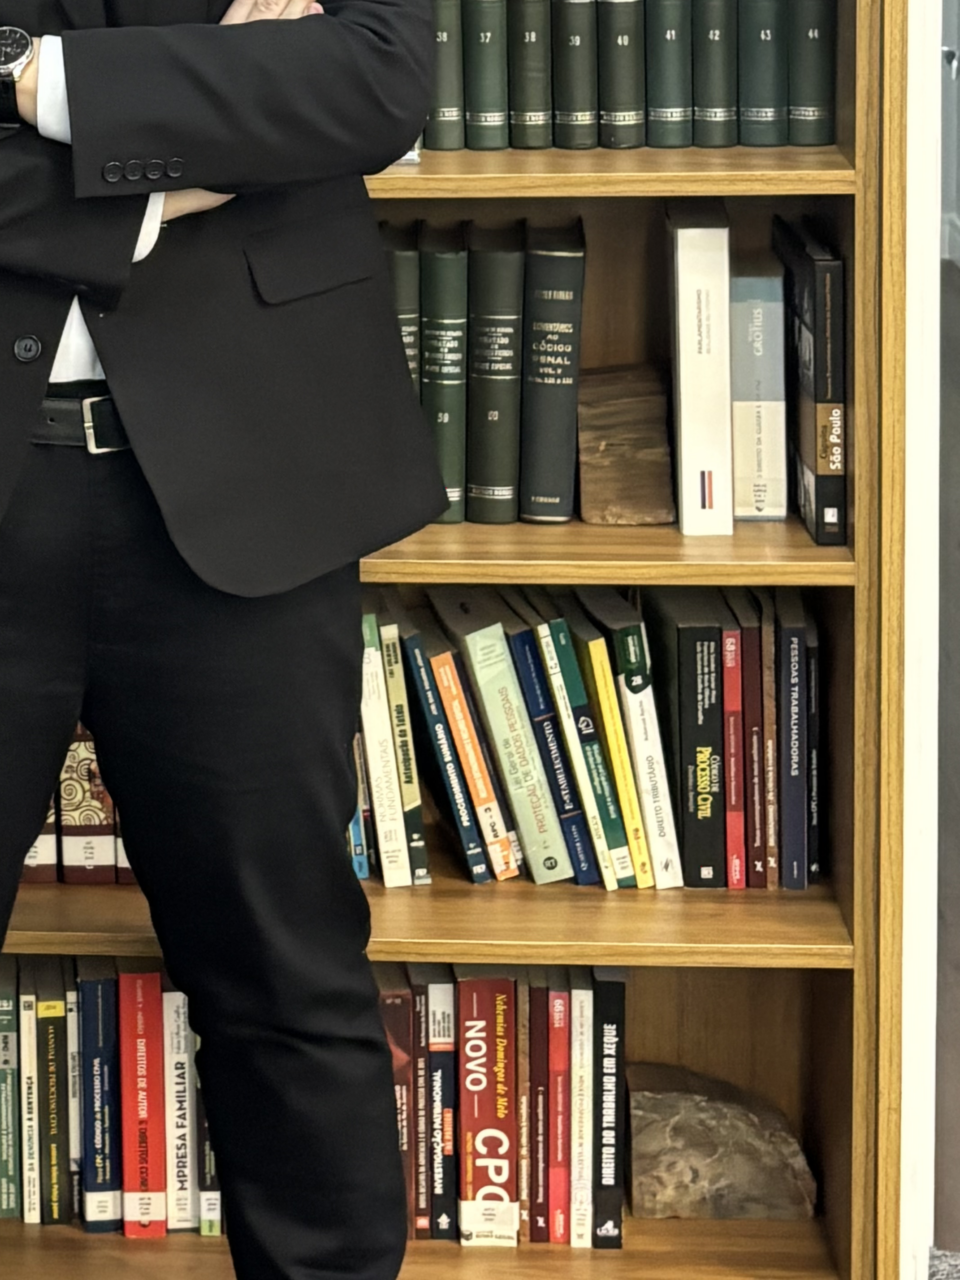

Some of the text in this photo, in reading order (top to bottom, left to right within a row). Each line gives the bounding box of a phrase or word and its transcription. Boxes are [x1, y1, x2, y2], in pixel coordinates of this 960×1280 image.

[617, 35, 629, 46] 40
[665, 30, 676, 40] 41
[708, 29, 720, 40] 42
[828, 408, 841, 470] São Paulo
[790, 637, 799, 777] PESSOAS TRABALHADORAS
[696, 746, 712, 820] PROCESSO CIVIL
[495, 993, 508, 1037] Nehemias
[464, 1019, 487, 1092] NOVO
[493, 1038, 508, 1081] Domingos
[173, 1061, 188, 1191] MPRESA FAMILIAR
[496, 1096, 508, 1119] Melo
[601, 1023, 618, 1186] DIREITO DO TRABALHO EM XEQUE
[474, 1128, 510, 1203] CPC
